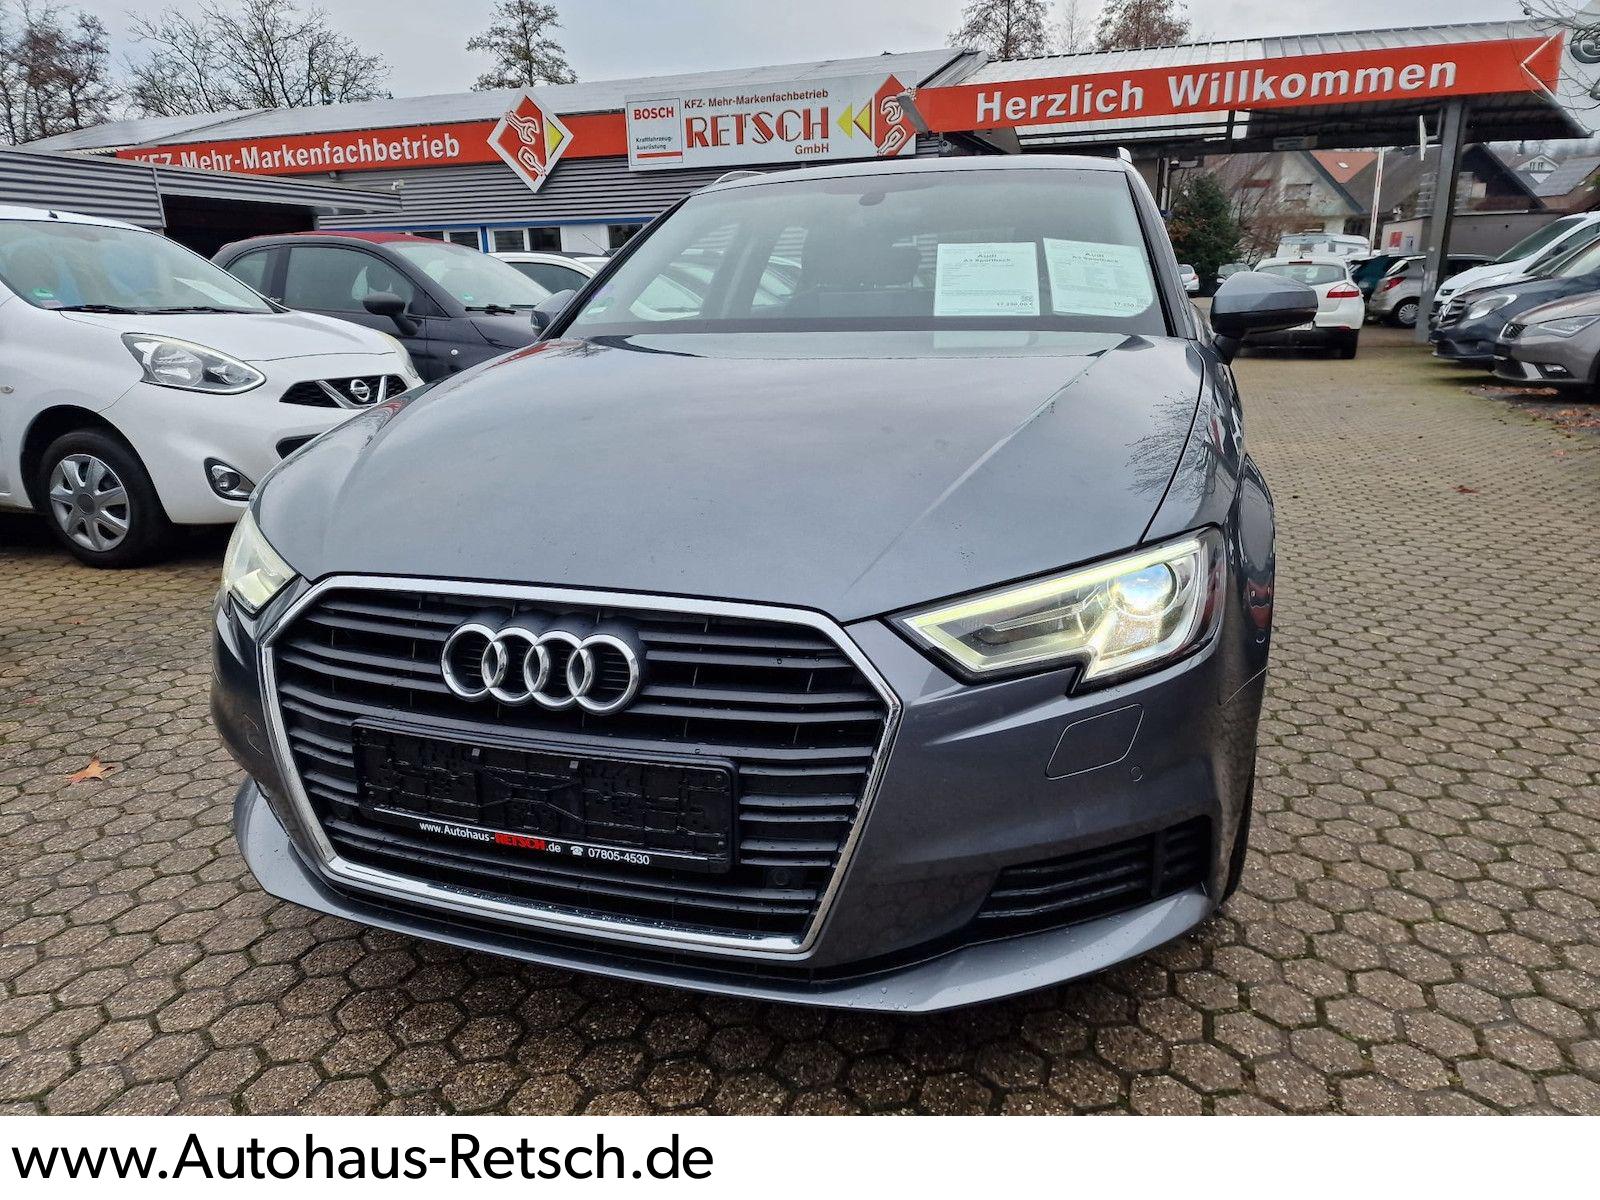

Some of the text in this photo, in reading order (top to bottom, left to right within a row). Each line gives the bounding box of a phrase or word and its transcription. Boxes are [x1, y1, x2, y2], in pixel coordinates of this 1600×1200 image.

[684, 89, 829, 109] KFZ- Mehr-Markenfachbetrieb
[976, 61, 1457, 124] Herzlich Willkommen
[633, 106, 674, 120] BOSCH
[685, 106, 829, 149] RETSCH
[795, 143, 829, 154] GmbH
[419, 821, 650, 865] www.Autohaus-RETSCH.de 07805-4530
